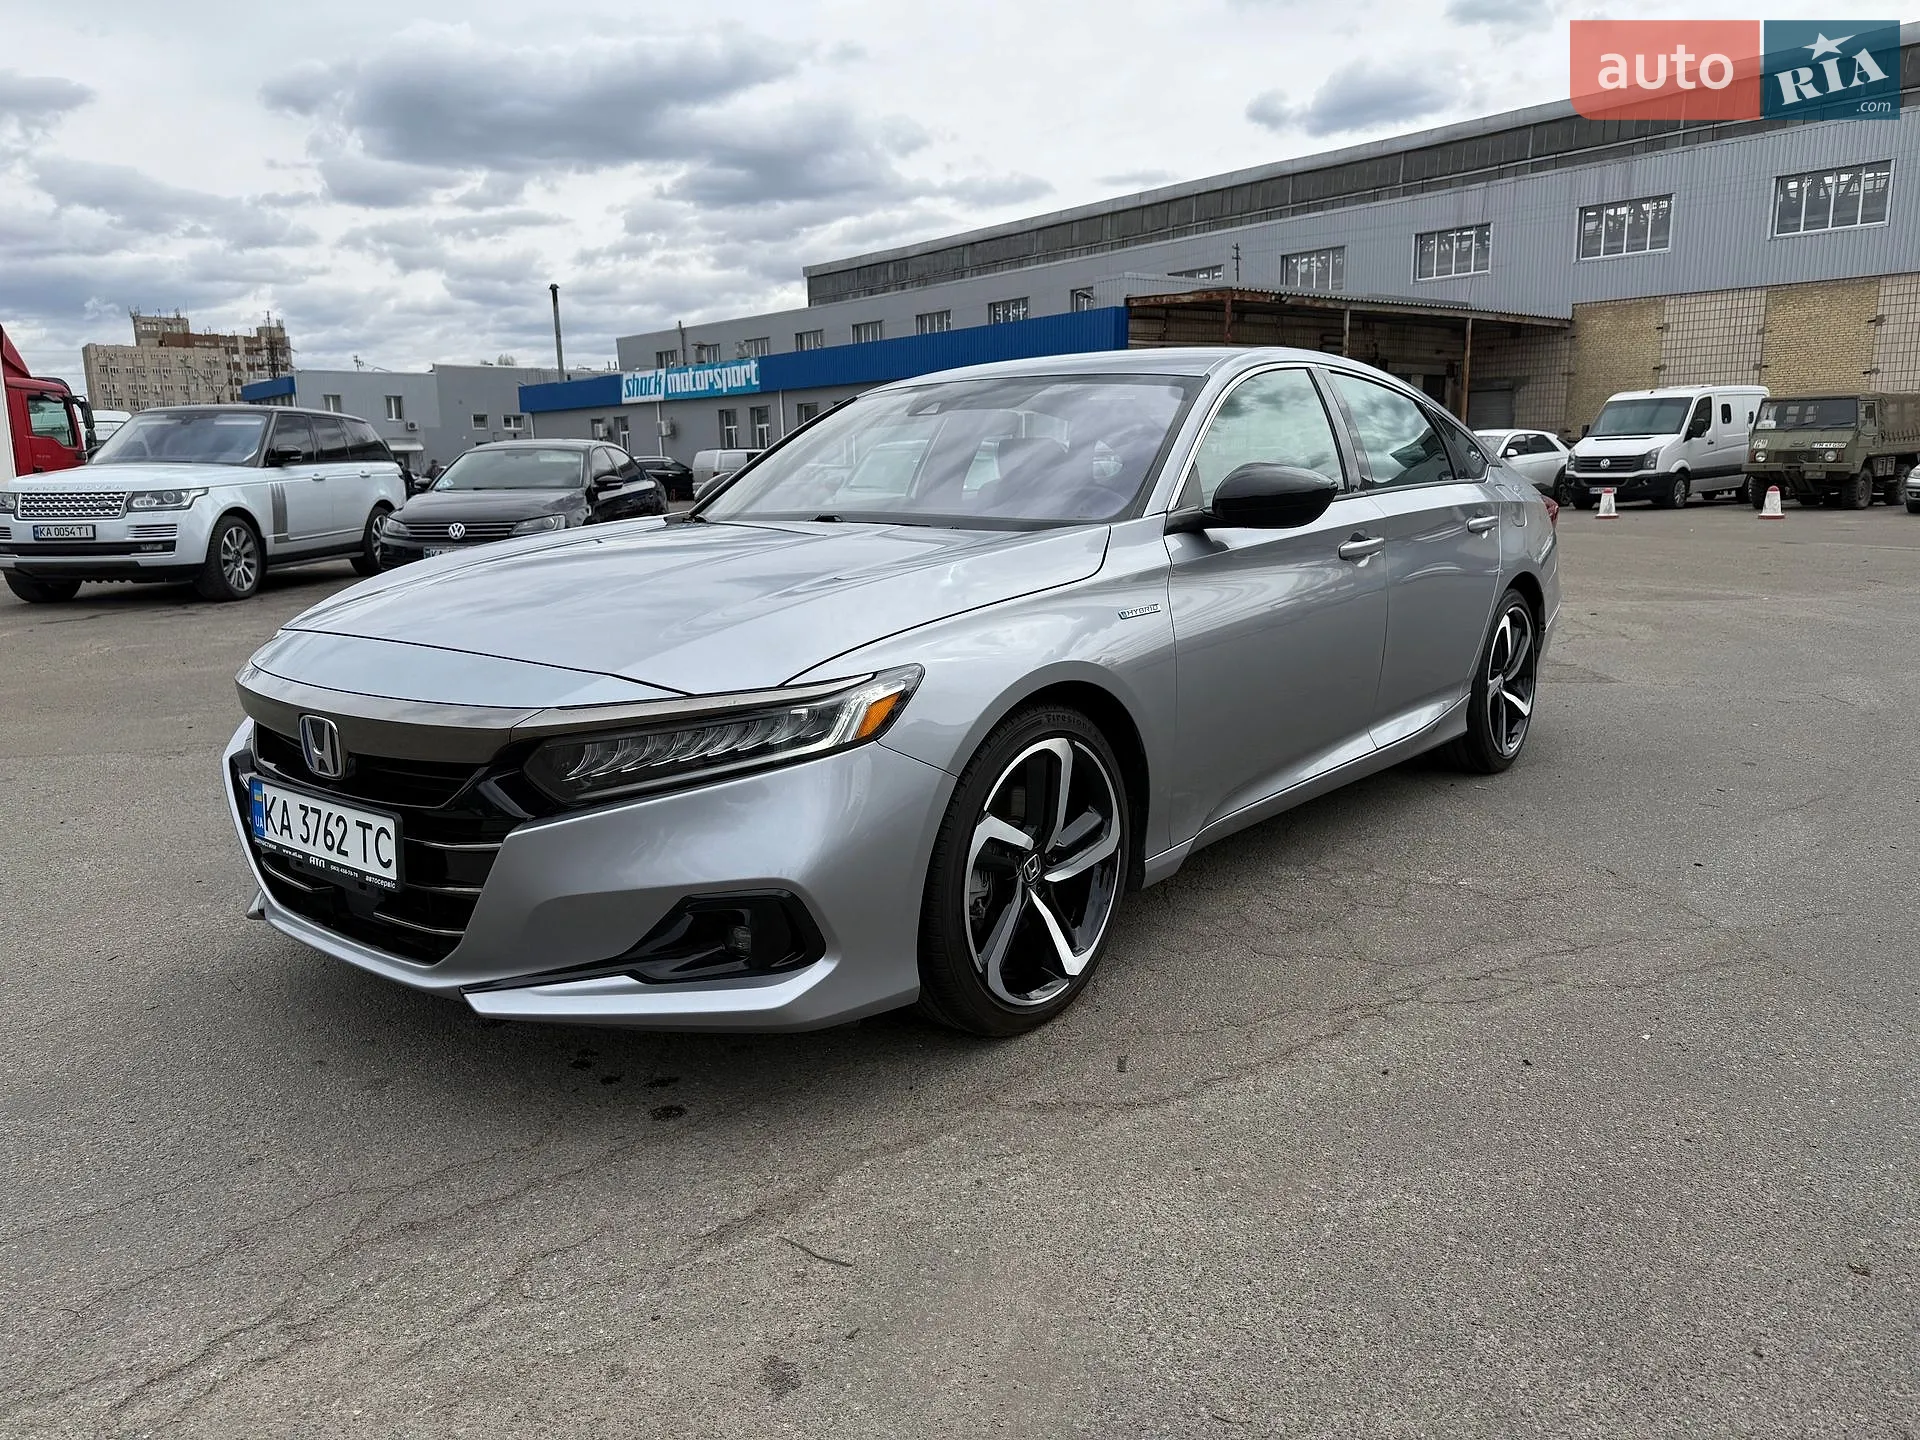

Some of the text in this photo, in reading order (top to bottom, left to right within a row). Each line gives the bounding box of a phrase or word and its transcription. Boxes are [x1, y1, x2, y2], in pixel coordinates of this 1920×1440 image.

[624, 359, 759, 398] shock motorsport
[39, 527, 52, 537] KA
[54, 526, 75, 537] 0054
[255, 816, 264, 828] UA
[264, 793, 393, 869] KA 3762 TC
